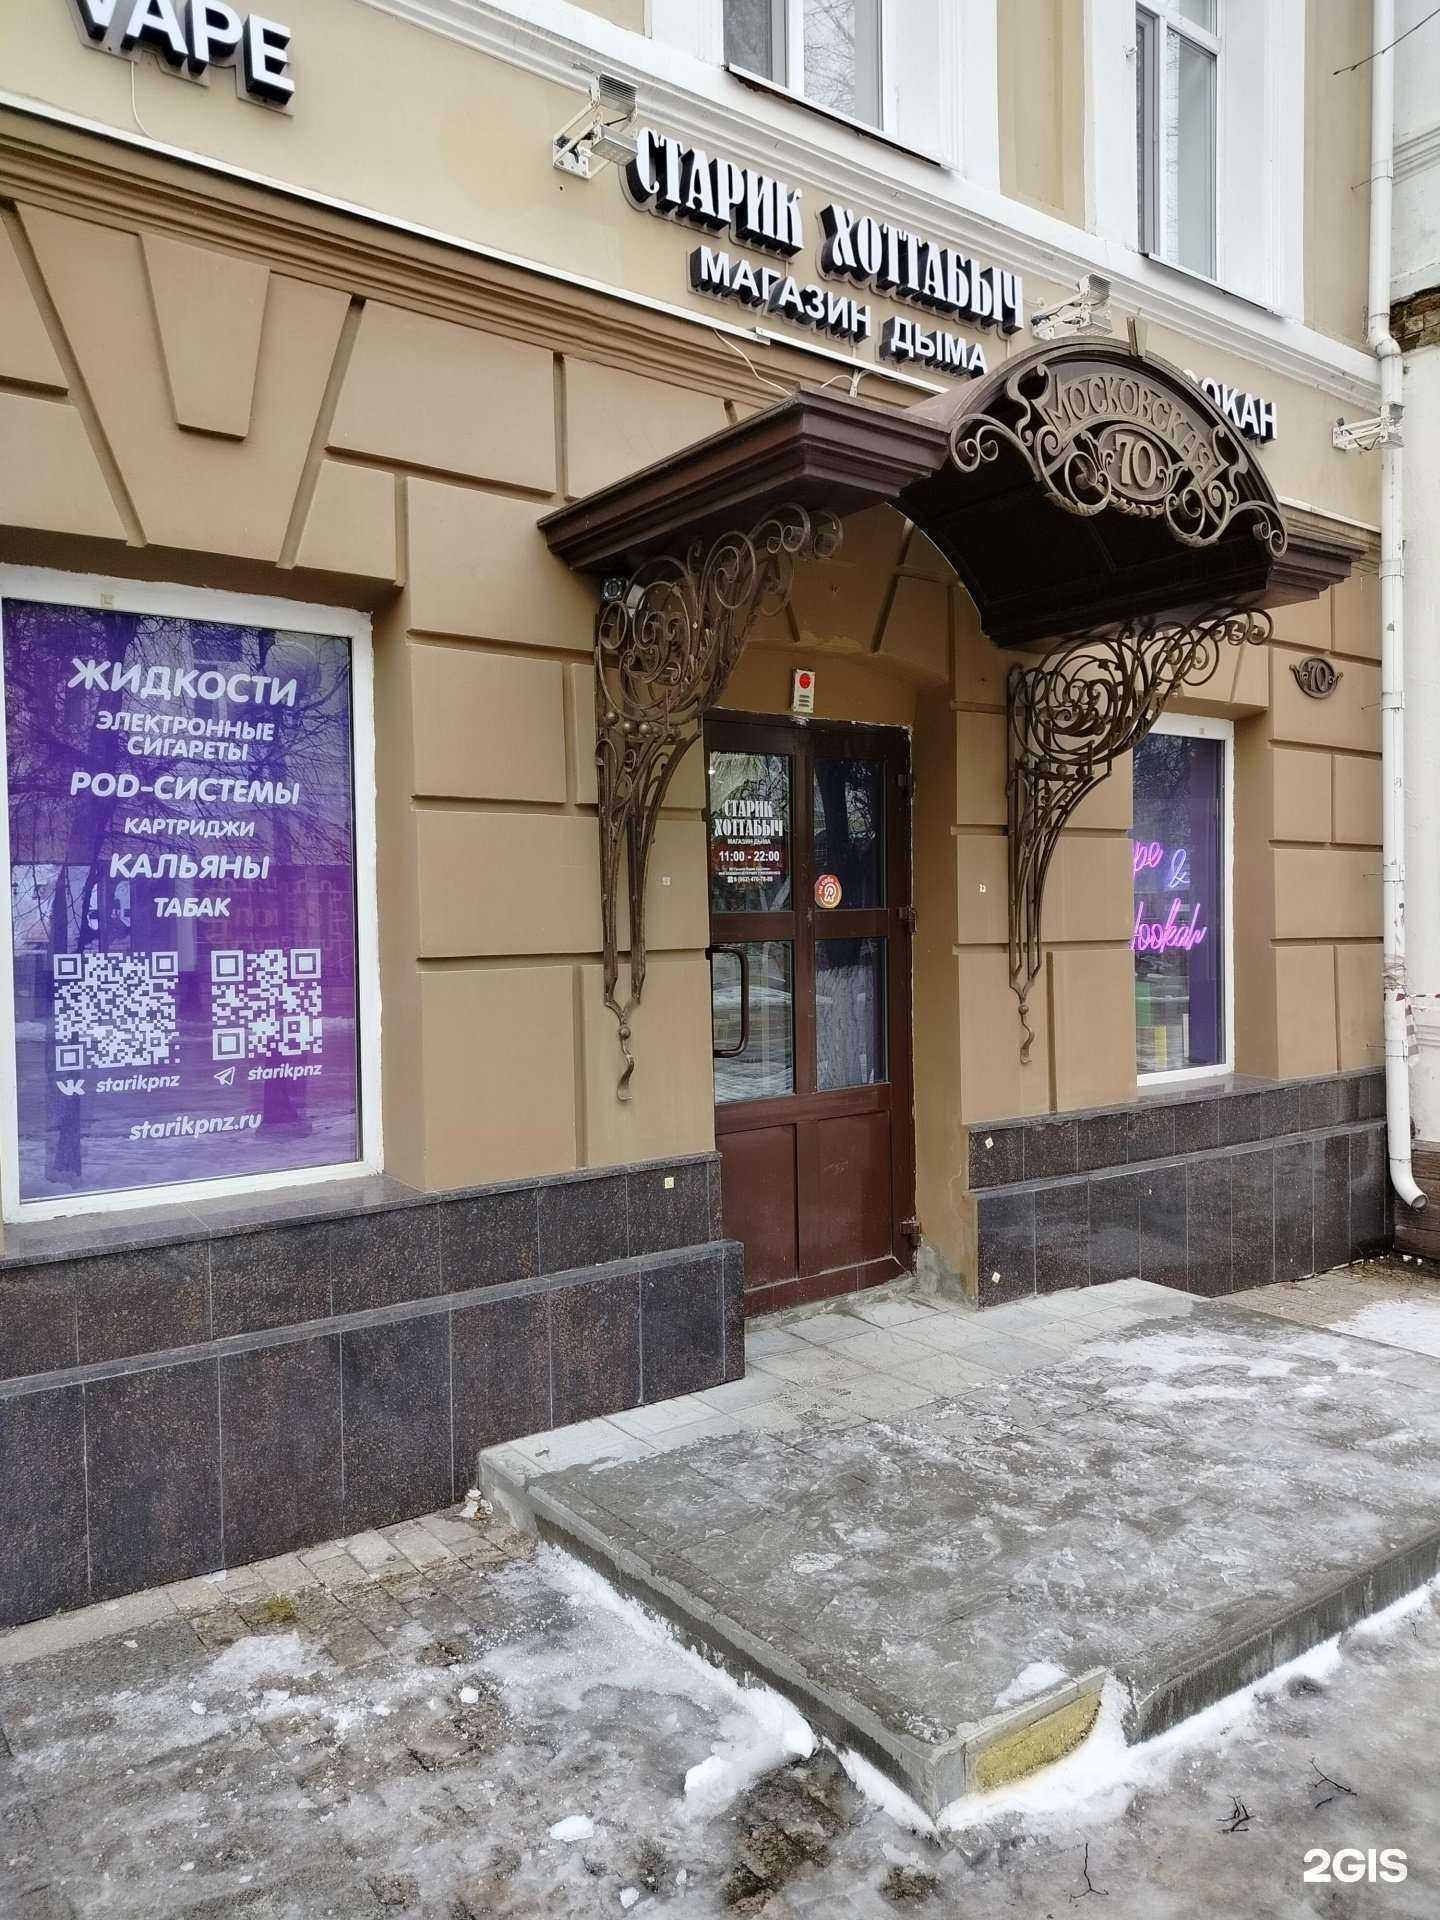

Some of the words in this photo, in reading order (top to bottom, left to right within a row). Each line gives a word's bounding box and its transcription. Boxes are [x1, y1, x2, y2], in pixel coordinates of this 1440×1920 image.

[632, 127, 804, 252] СТАРИК
[826, 204, 1024, 332] ХОТТАБЫЧ
[698, 246, 872, 338] МАГАЗИН
[888, 316, 988, 376] ДЫМА
[1045, 374, 1219, 474] МОСКОВСКАЯ
[1115, 431, 1158, 490] 70
[67, 657, 298, 707] ЖИДКОСТИ
[1308, 661, 1329, 692] 70
[96, 710, 275, 741] ЭЛЕКТРОННЫЕ
[127, 736, 248, 761] СИГАРЕТЫ
[70, 772, 299, 805] POD-СИСТЕМЫ
[724, 800, 773, 817] СТАРИК
[124, 817, 255, 838] КАРТРИДЖИ
[714, 818, 783, 837] ХОТТАБЫЧ
[109, 853, 269, 879] КАЛЬЯНЫ
[719, 850, 745, 862] 11:00
[753, 850, 780, 862] 22:00
[154, 898, 231, 917] ТАБАК
[96, 1074, 180, 1093] starikpnz
[248, 1063, 323, 1081] starikpnz
[129, 1112, 262, 1142] starikpnz.ru
